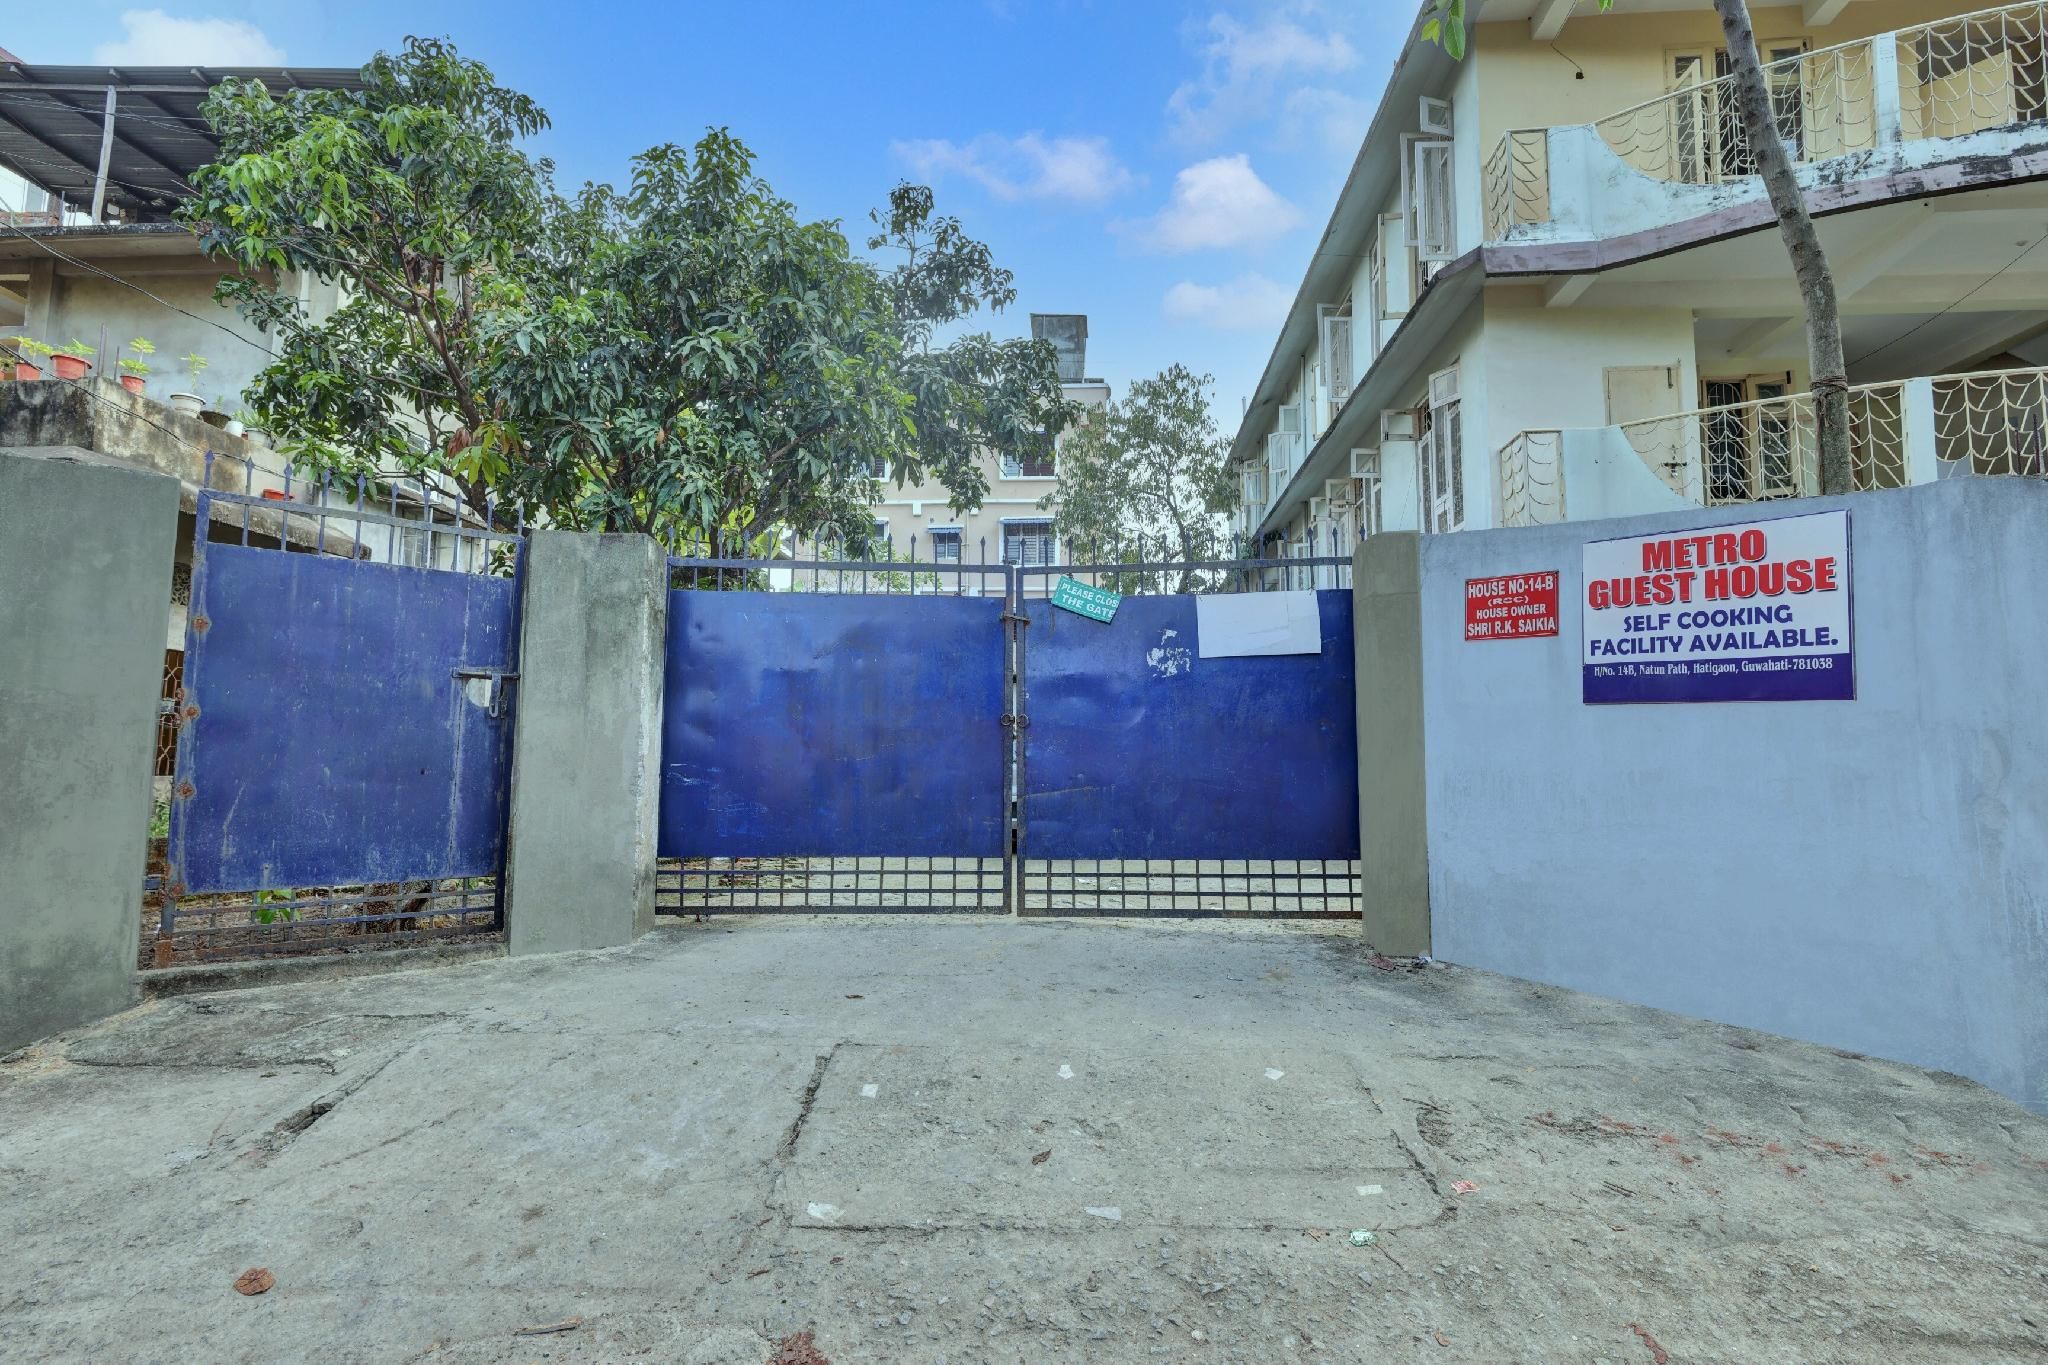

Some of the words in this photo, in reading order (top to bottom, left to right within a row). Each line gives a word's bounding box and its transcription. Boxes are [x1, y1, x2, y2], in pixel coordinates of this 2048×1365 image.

[1642, 529, 1767, 572] METRO
[1061, 582, 1095, 601] PLEASE
[1095, 594, 1120, 608] CLOS
[1468, 581, 1506, 598] HOUSE
[1508, 575, 1554, 594] NO-14-B
[1588, 571, 1696, 610] GUEST
[1704, 556, 1838, 601] HOUSE
[1062, 593, 1084, 609] THE
[1086, 603, 1116, 618] GATE
[1476, 607, 1508, 620] HOUSE
[1511, 603, 1546, 616] OWNER
[1488, 595, 1529, 607] (RCC)
[1467, 622, 1492, 636] SHRI
[1495, 620, 1515, 634] R.K.
[1518, 617, 1556, 633] SAIKIA
[1623, 613, 1671, 633] SELF
[1677, 604, 1793, 630] COOKING
[1590, 635, 1684, 656] FACILITY
[1689, 626, 1839, 652] AVAILABLE.
[1618, 664, 1637, 676] 14B,
[1640, 664, 1666, 675] Natun
[1667, 663, 1690, 676] Path,
[1693, 661, 1739, 676] Hatigaon,
